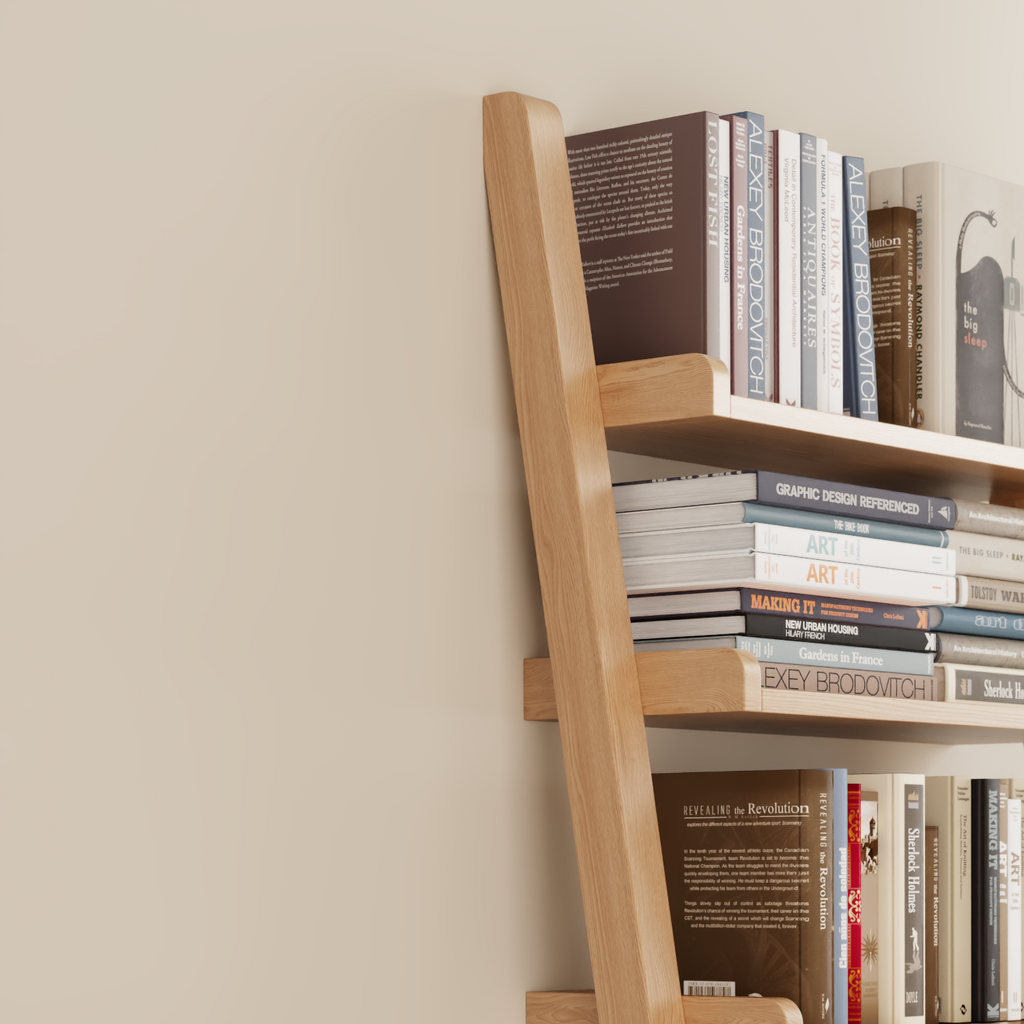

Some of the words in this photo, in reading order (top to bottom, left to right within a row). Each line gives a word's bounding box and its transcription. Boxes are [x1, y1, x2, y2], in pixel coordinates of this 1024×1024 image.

[708, 119, 718, 186] LOST
[749, 118, 763, 222] ALEXEY
[708, 191, 718, 247] FISH
[849, 162, 868, 257] ALEXEY
[737, 205, 745, 262] Gardens
[737, 265, 744, 279] in
[805, 207, 816, 348] ANTIQUAIRES
[737, 282, 745, 331] France
[750, 228, 764, 394] BRODOVITCH
[964, 301, 977, 315] the
[964, 316, 978, 333] big
[854, 263, 877, 414] BRODOVITCH
[964, 335, 987, 351] sleep
[776, 483, 820, 501] GRAPHIC
[822, 490, 857, 506] DESIGN
[860, 496, 920, 515] REFERENCED
[834, 520, 844, 530] THE
[845, 521, 857, 533] BIKE
[857, 523, 870, 534] BOOK
[806, 534, 838, 556] ART
[959, 546, 970, 556] THE
[972, 548, 984, 558] BIG
[986, 551, 1004, 560] SLEEP
[806, 563, 838, 585] ART
[751, 594, 800, 613] MAKING
[803, 600, 816, 614] IT
[971, 585, 997, 602] TOLSTOY
[785, 619, 802, 630] NEW
[803, 621, 826, 633] URBAN
[828, 624, 859, 636] HOUSING
[975, 614, 1008, 629] art
[785, 630, 805, 639] HILARY
[806, 631, 825, 640] FRENCH
[800, 647, 838, 663] Gardens
[840, 652, 849, 664] in
[852, 651, 883, 667] France
[817, 671, 925, 699] BRODOVITCH
[984, 679, 1013, 700] Sherlock
[684, 805, 730, 816] REVEALING
[734, 806, 745, 815] the
[748, 801, 810, 815] Revolution
[819, 793, 828, 848] REVEALING
[988, 790, 998, 851] MAKING
[819, 852, 827, 864] the
[908, 828, 920, 872] Sherlock
[988, 854, 998, 870] IT
[839, 848, 848, 892] soledad
[1011, 851, 1019, 886] ART
[819, 867, 829, 930] Revolution
[839, 895, 848, 909] de
[908, 876, 920, 914] Holmes
[839, 913, 847, 941] años
[839, 944, 847, 969] Cien
